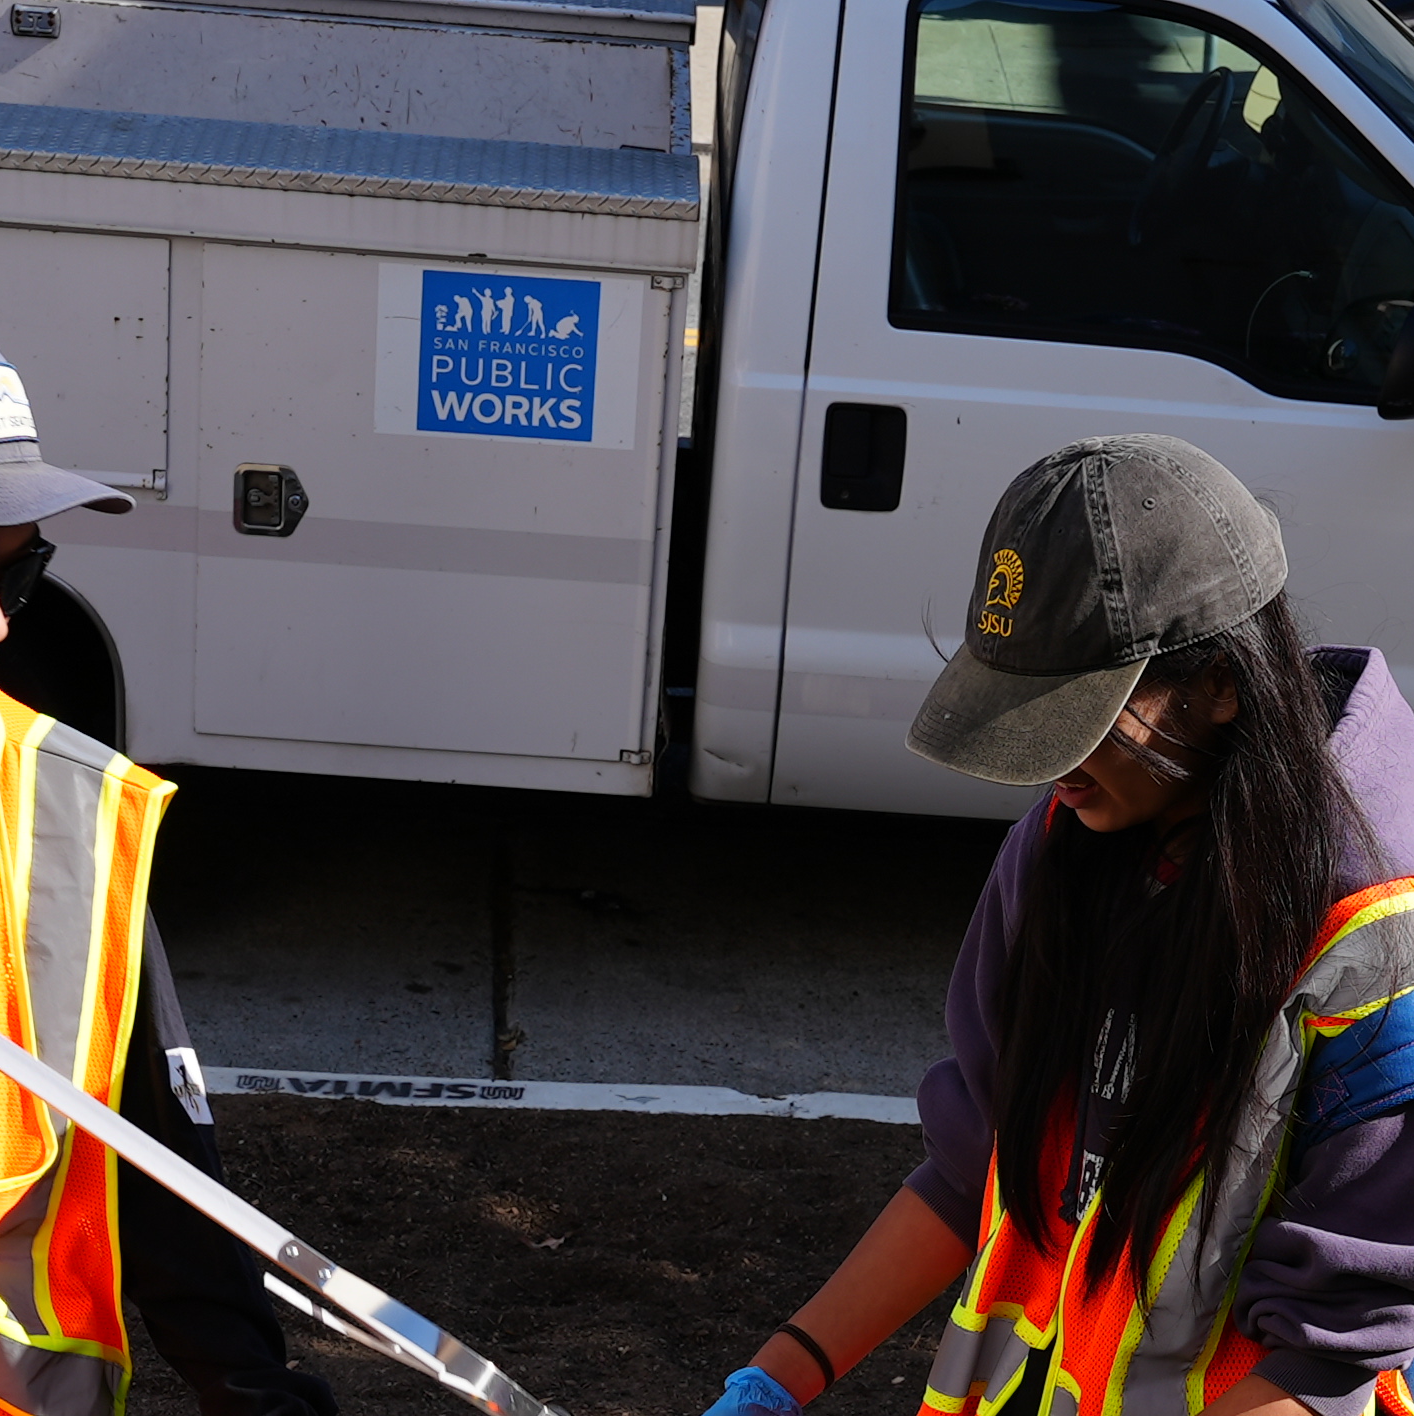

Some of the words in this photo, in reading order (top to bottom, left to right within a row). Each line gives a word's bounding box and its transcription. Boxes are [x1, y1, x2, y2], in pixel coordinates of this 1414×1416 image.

[433, 336, 469, 351] SAN
[478, 340, 585, 359] FRANCISCO
[431, 354, 583, 393] PUBLIC
[430, 389, 582, 430] WORKS
[977, 610, 1014, 637] SJSU
[287, 1077, 480, 1101] SFMTA
